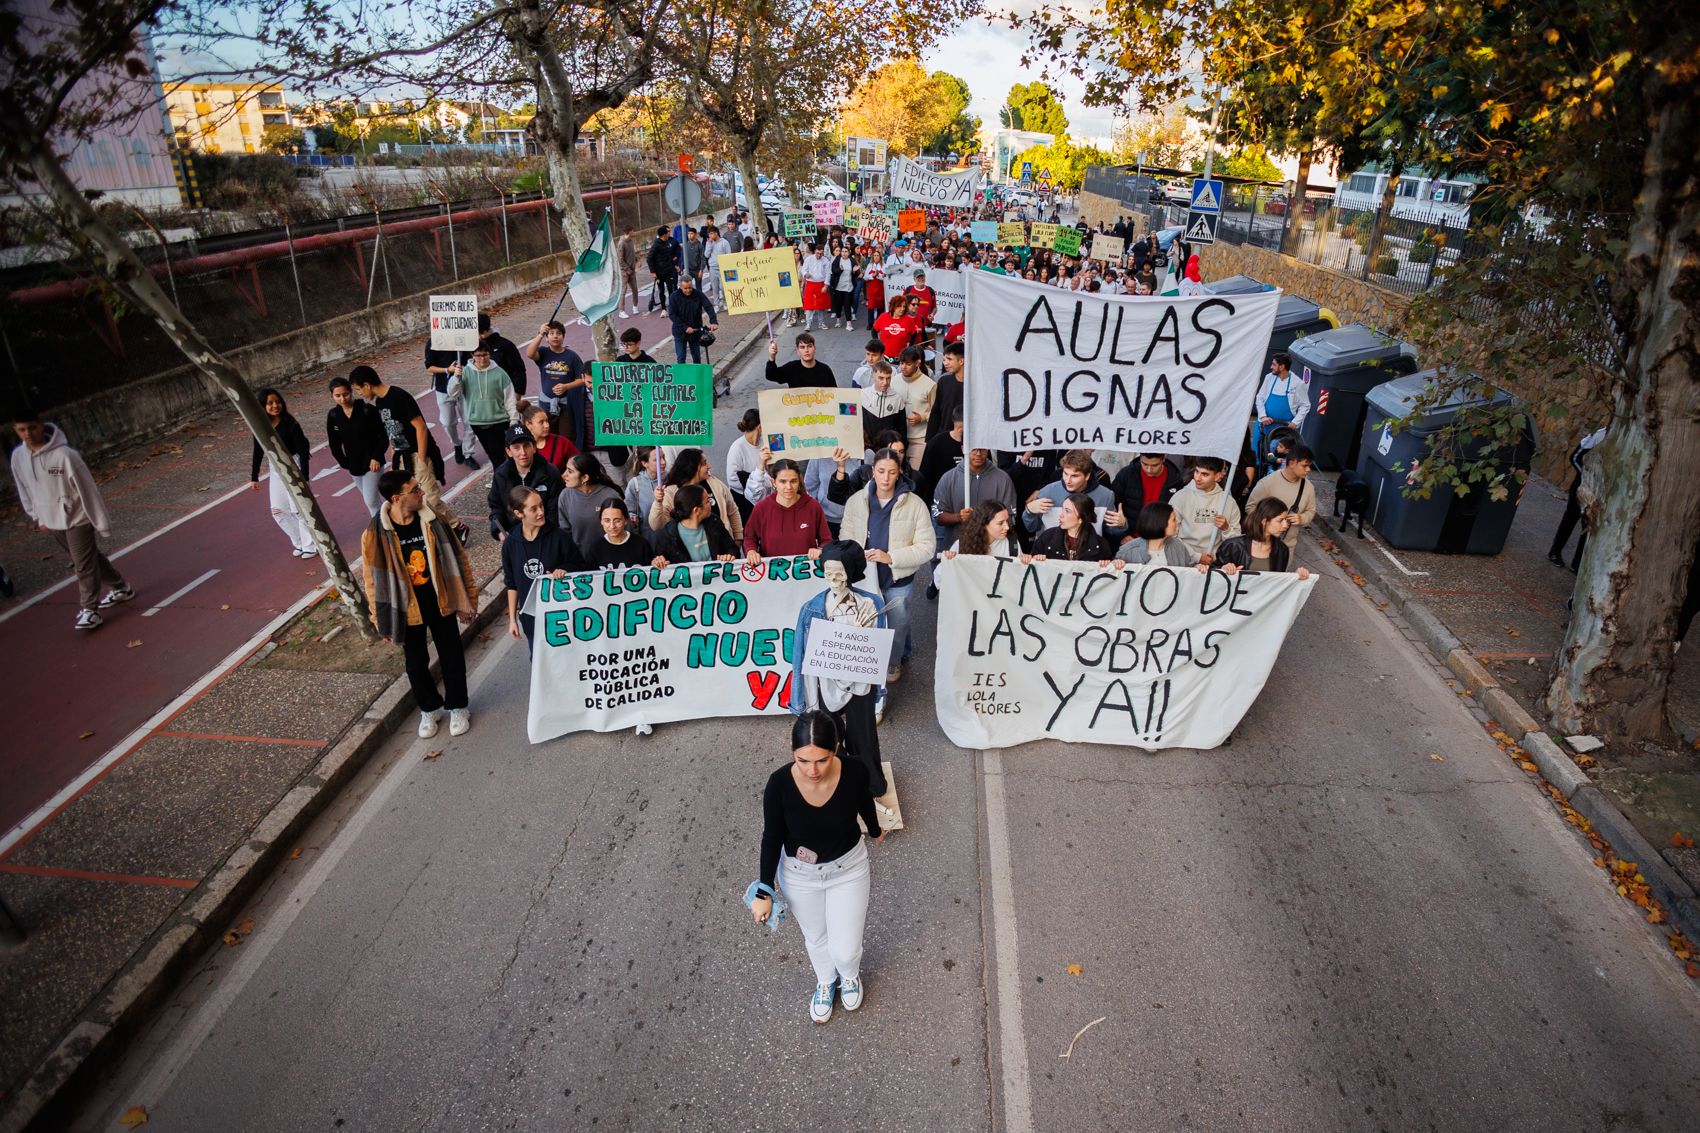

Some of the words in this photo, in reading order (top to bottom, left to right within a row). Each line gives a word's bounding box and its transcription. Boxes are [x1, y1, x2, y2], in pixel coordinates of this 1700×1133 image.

[904, 162, 953, 188] EDIFICIO
[900, 176, 947, 200] NUEVO
[952, 178, 971, 201] YA
[861, 212, 886, 224] EDIFICIO
[867, 220, 890, 232] NUEVO
[805, 224, 816, 234] NO
[458, 301, 474, 312] AULAS
[432, 316, 439, 330] NO
[1015, 295, 1235, 369] AULAS
[601, 364, 673, 384] QUEREMOS
[598, 384, 624, 402] QUE
[630, 384, 643, 401] SE
[652, 384, 697, 402] CUMPLE
[1003, 368, 1207, 424] DIGNAS
[624, 402, 643, 419] LA
[652, 403, 677, 419] LEY
[1013, 427, 1043, 447] IES
[1052, 427, 1104, 445] LOLA
[1115, 427, 1191, 445] FLORES
[541, 574, 593, 602] IES
[603, 565, 692, 597] LOLA
[987, 556, 1179, 619] INICIO
[1200, 568, 1261, 616] DE
[545, 590, 748, 647] EDIFICIO
[822, 639, 876, 654] ESPERANDO
[844, 632, 870, 643] AÑOS
[968, 608, 1046, 662] LAS
[1075, 625, 1231, 673] OBRAS
[587, 653, 619, 666] POR
[623, 646, 656, 662] UNA
[814, 648, 826, 658] LA
[827, 651, 879, 665] EDUCACIÓN
[579, 658, 670, 681] EDUCACIÓN
[809, 658, 822, 667] EN
[823, 661, 842, 671] LOS
[843, 664, 879, 675] HUESOS
[594, 673, 660, 695] PÚBLICA
[973, 672, 1007, 687] IES
[585, 697, 603, 710] DE
[607, 685, 675, 709] CALIDAD
[967, 691, 996, 702] LOLA
[1043, 671, 1171, 742] YA!!
[974, 702, 1021, 715] FLORES
